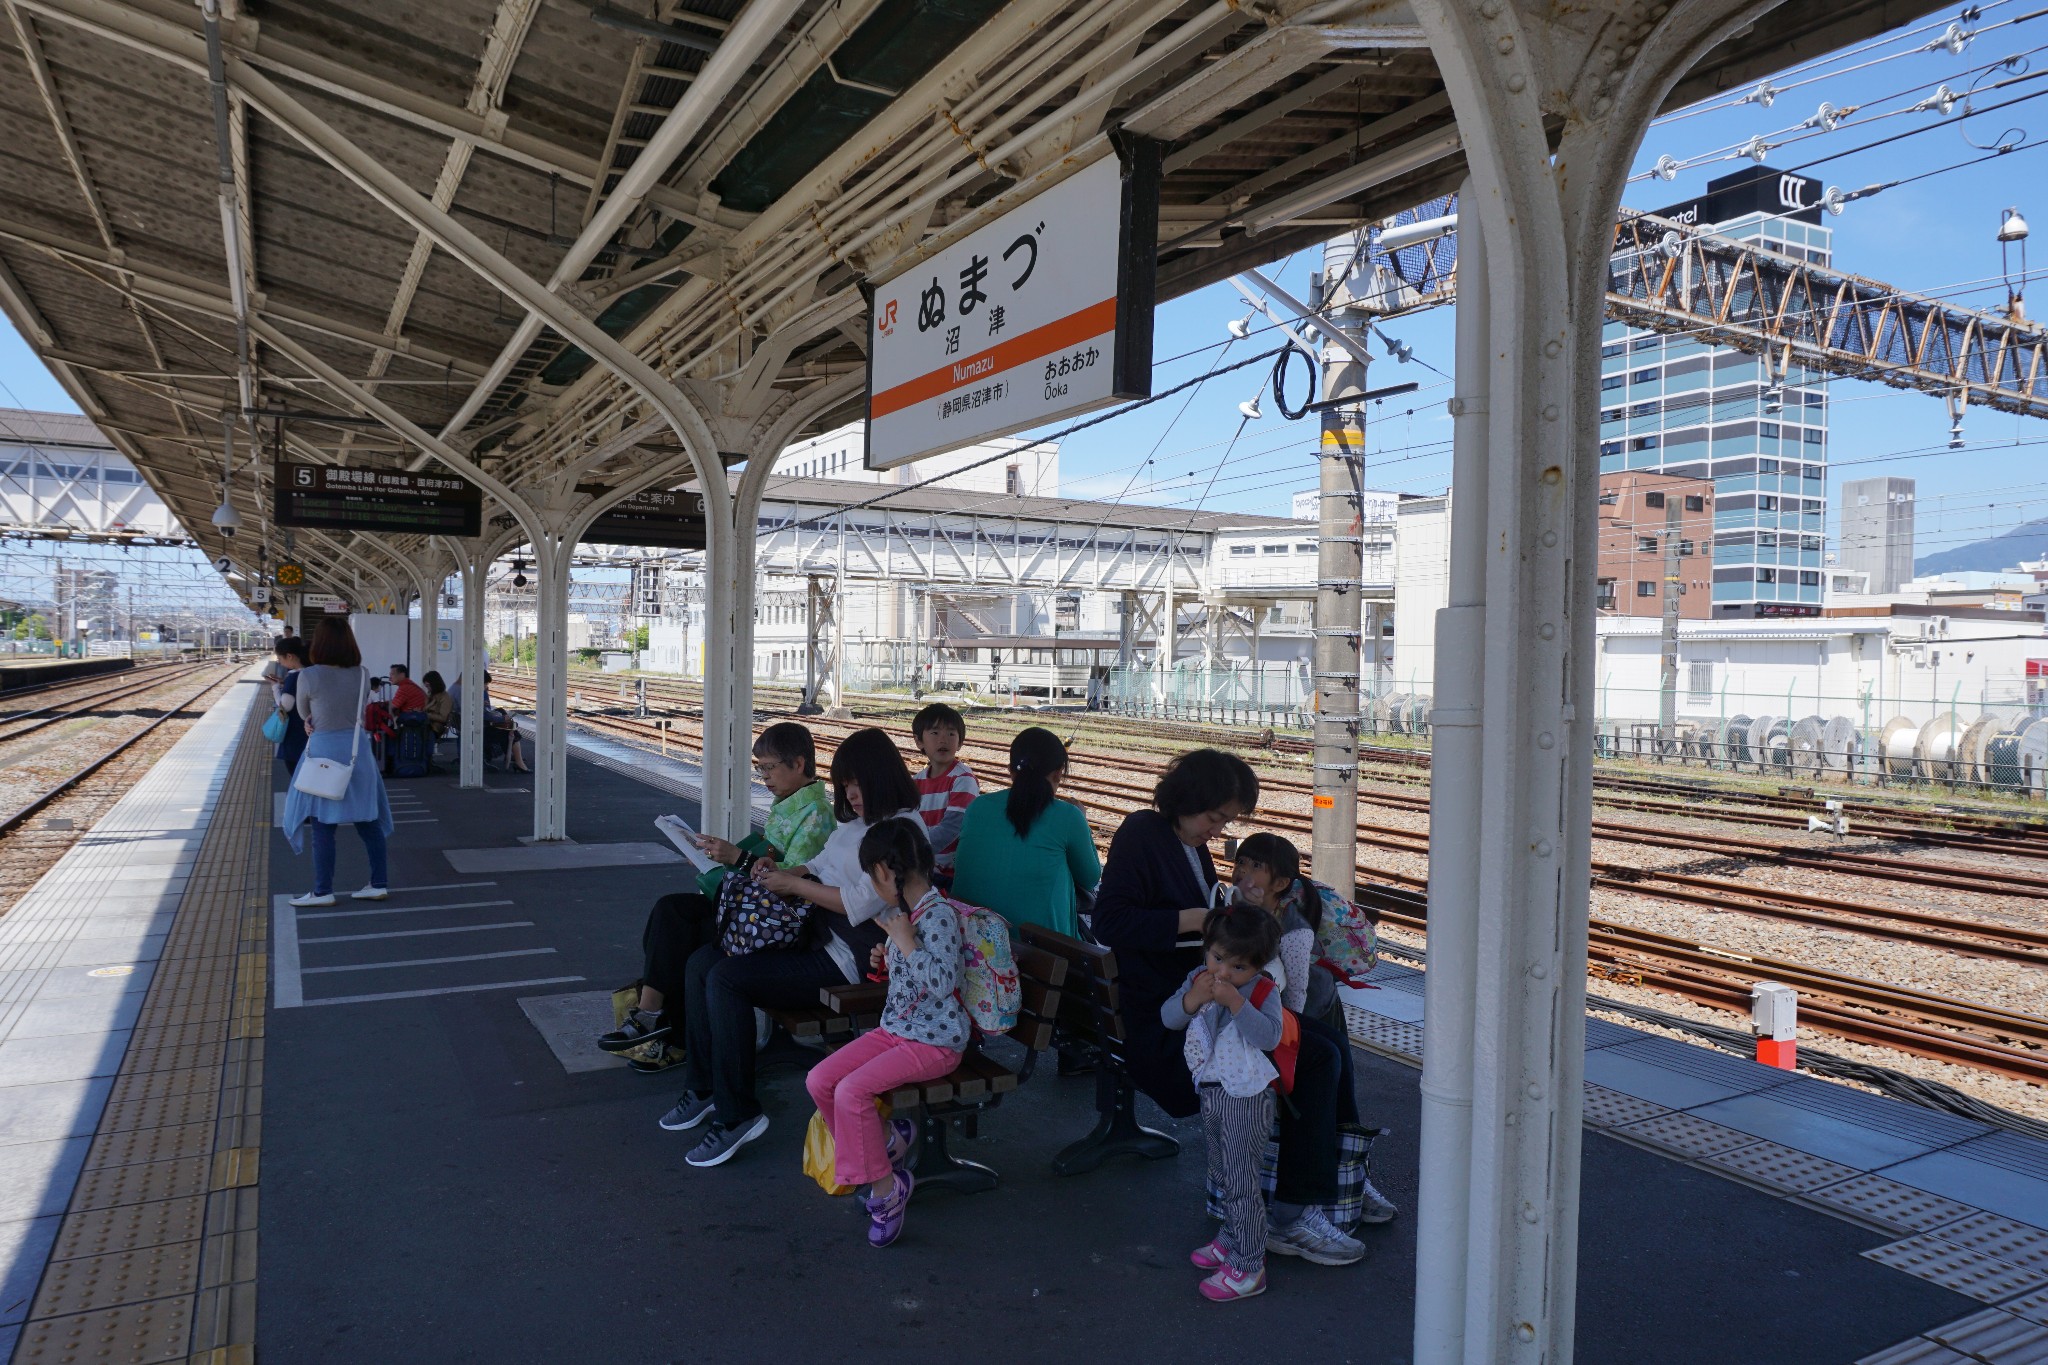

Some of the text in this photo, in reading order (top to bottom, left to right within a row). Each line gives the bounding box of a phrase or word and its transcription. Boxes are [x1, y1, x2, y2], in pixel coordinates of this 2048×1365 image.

[918, 221, 1045, 332] ぬまづ
[879, 299, 897, 330] JR
[953, 355, 994, 383] Numazu
[1045, 346, 1099, 381] おおおか
[298, 469, 311, 485] 5
[326, 483, 356, 492] Gotemba
[697, 499, 706, 512] 6
[218, 558, 231, 573] 2
[257, 590, 265, 599] 5
[447, 597, 455, 606] 6
